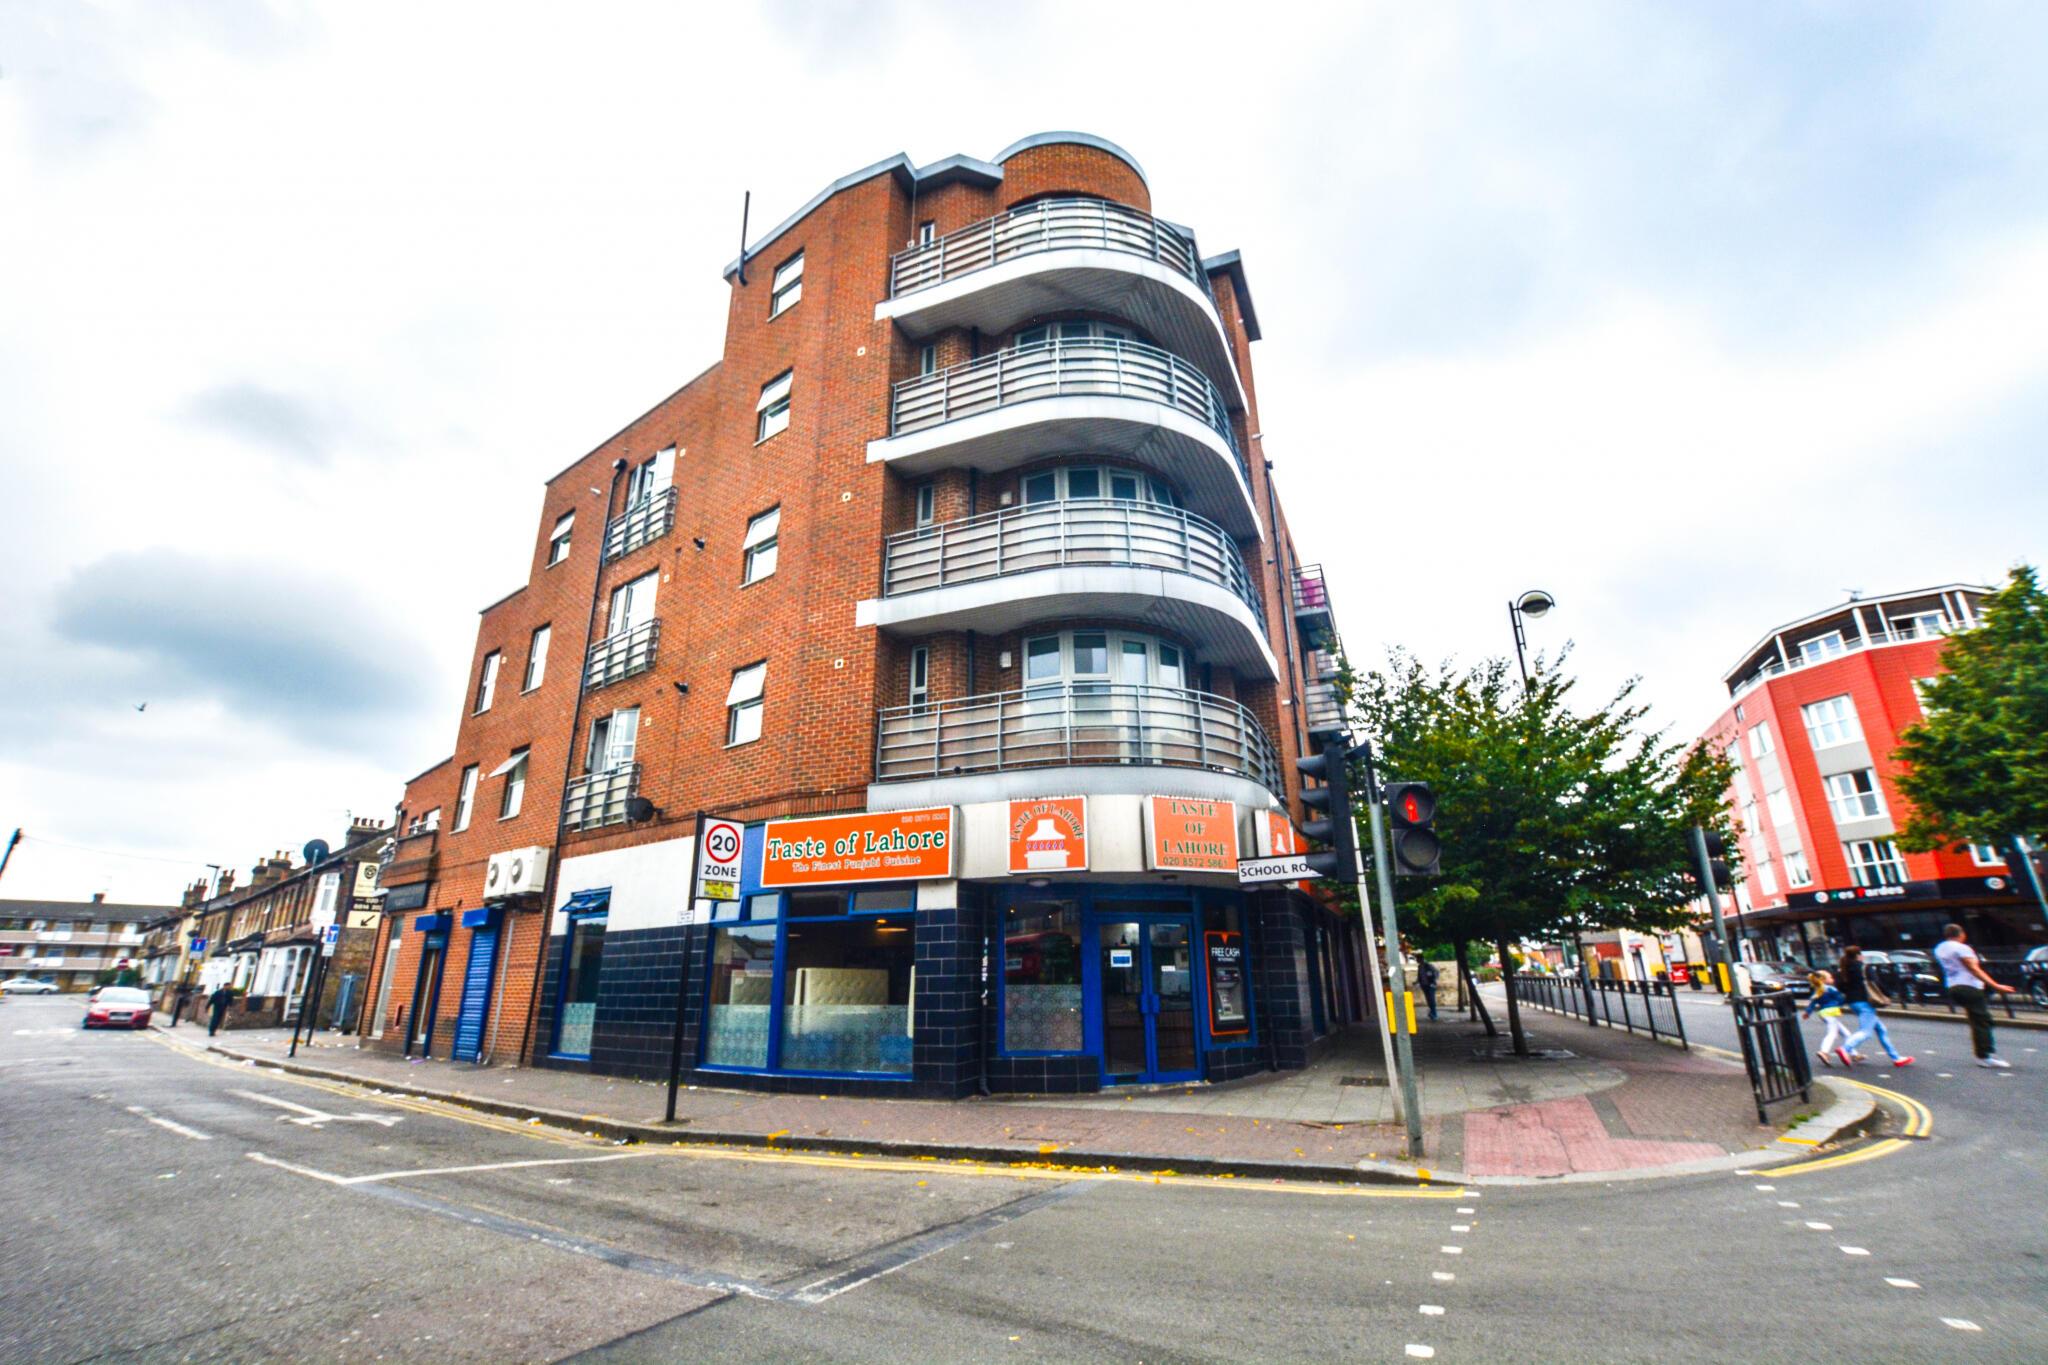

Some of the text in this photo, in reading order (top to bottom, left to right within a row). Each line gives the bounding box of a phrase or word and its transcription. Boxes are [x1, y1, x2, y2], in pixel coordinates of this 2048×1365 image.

[1171, 802, 1217, 816] TASTE
[1010, 803, 1084, 841] TASTE OF LAHORE
[1184, 822, 1206, 836] OF
[712, 834, 736, 852] 20
[768, 828, 946, 860] Taste of Lahore
[1162, 839, 1228, 856] LAHORE
[792, 855, 921, 873] The Finest Punjabi Cuisine
[1163, 856, 1179, 866] 020
[705, 864, 737, 877] ZONE
[1241, 864, 1289, 877] SCHOOL
